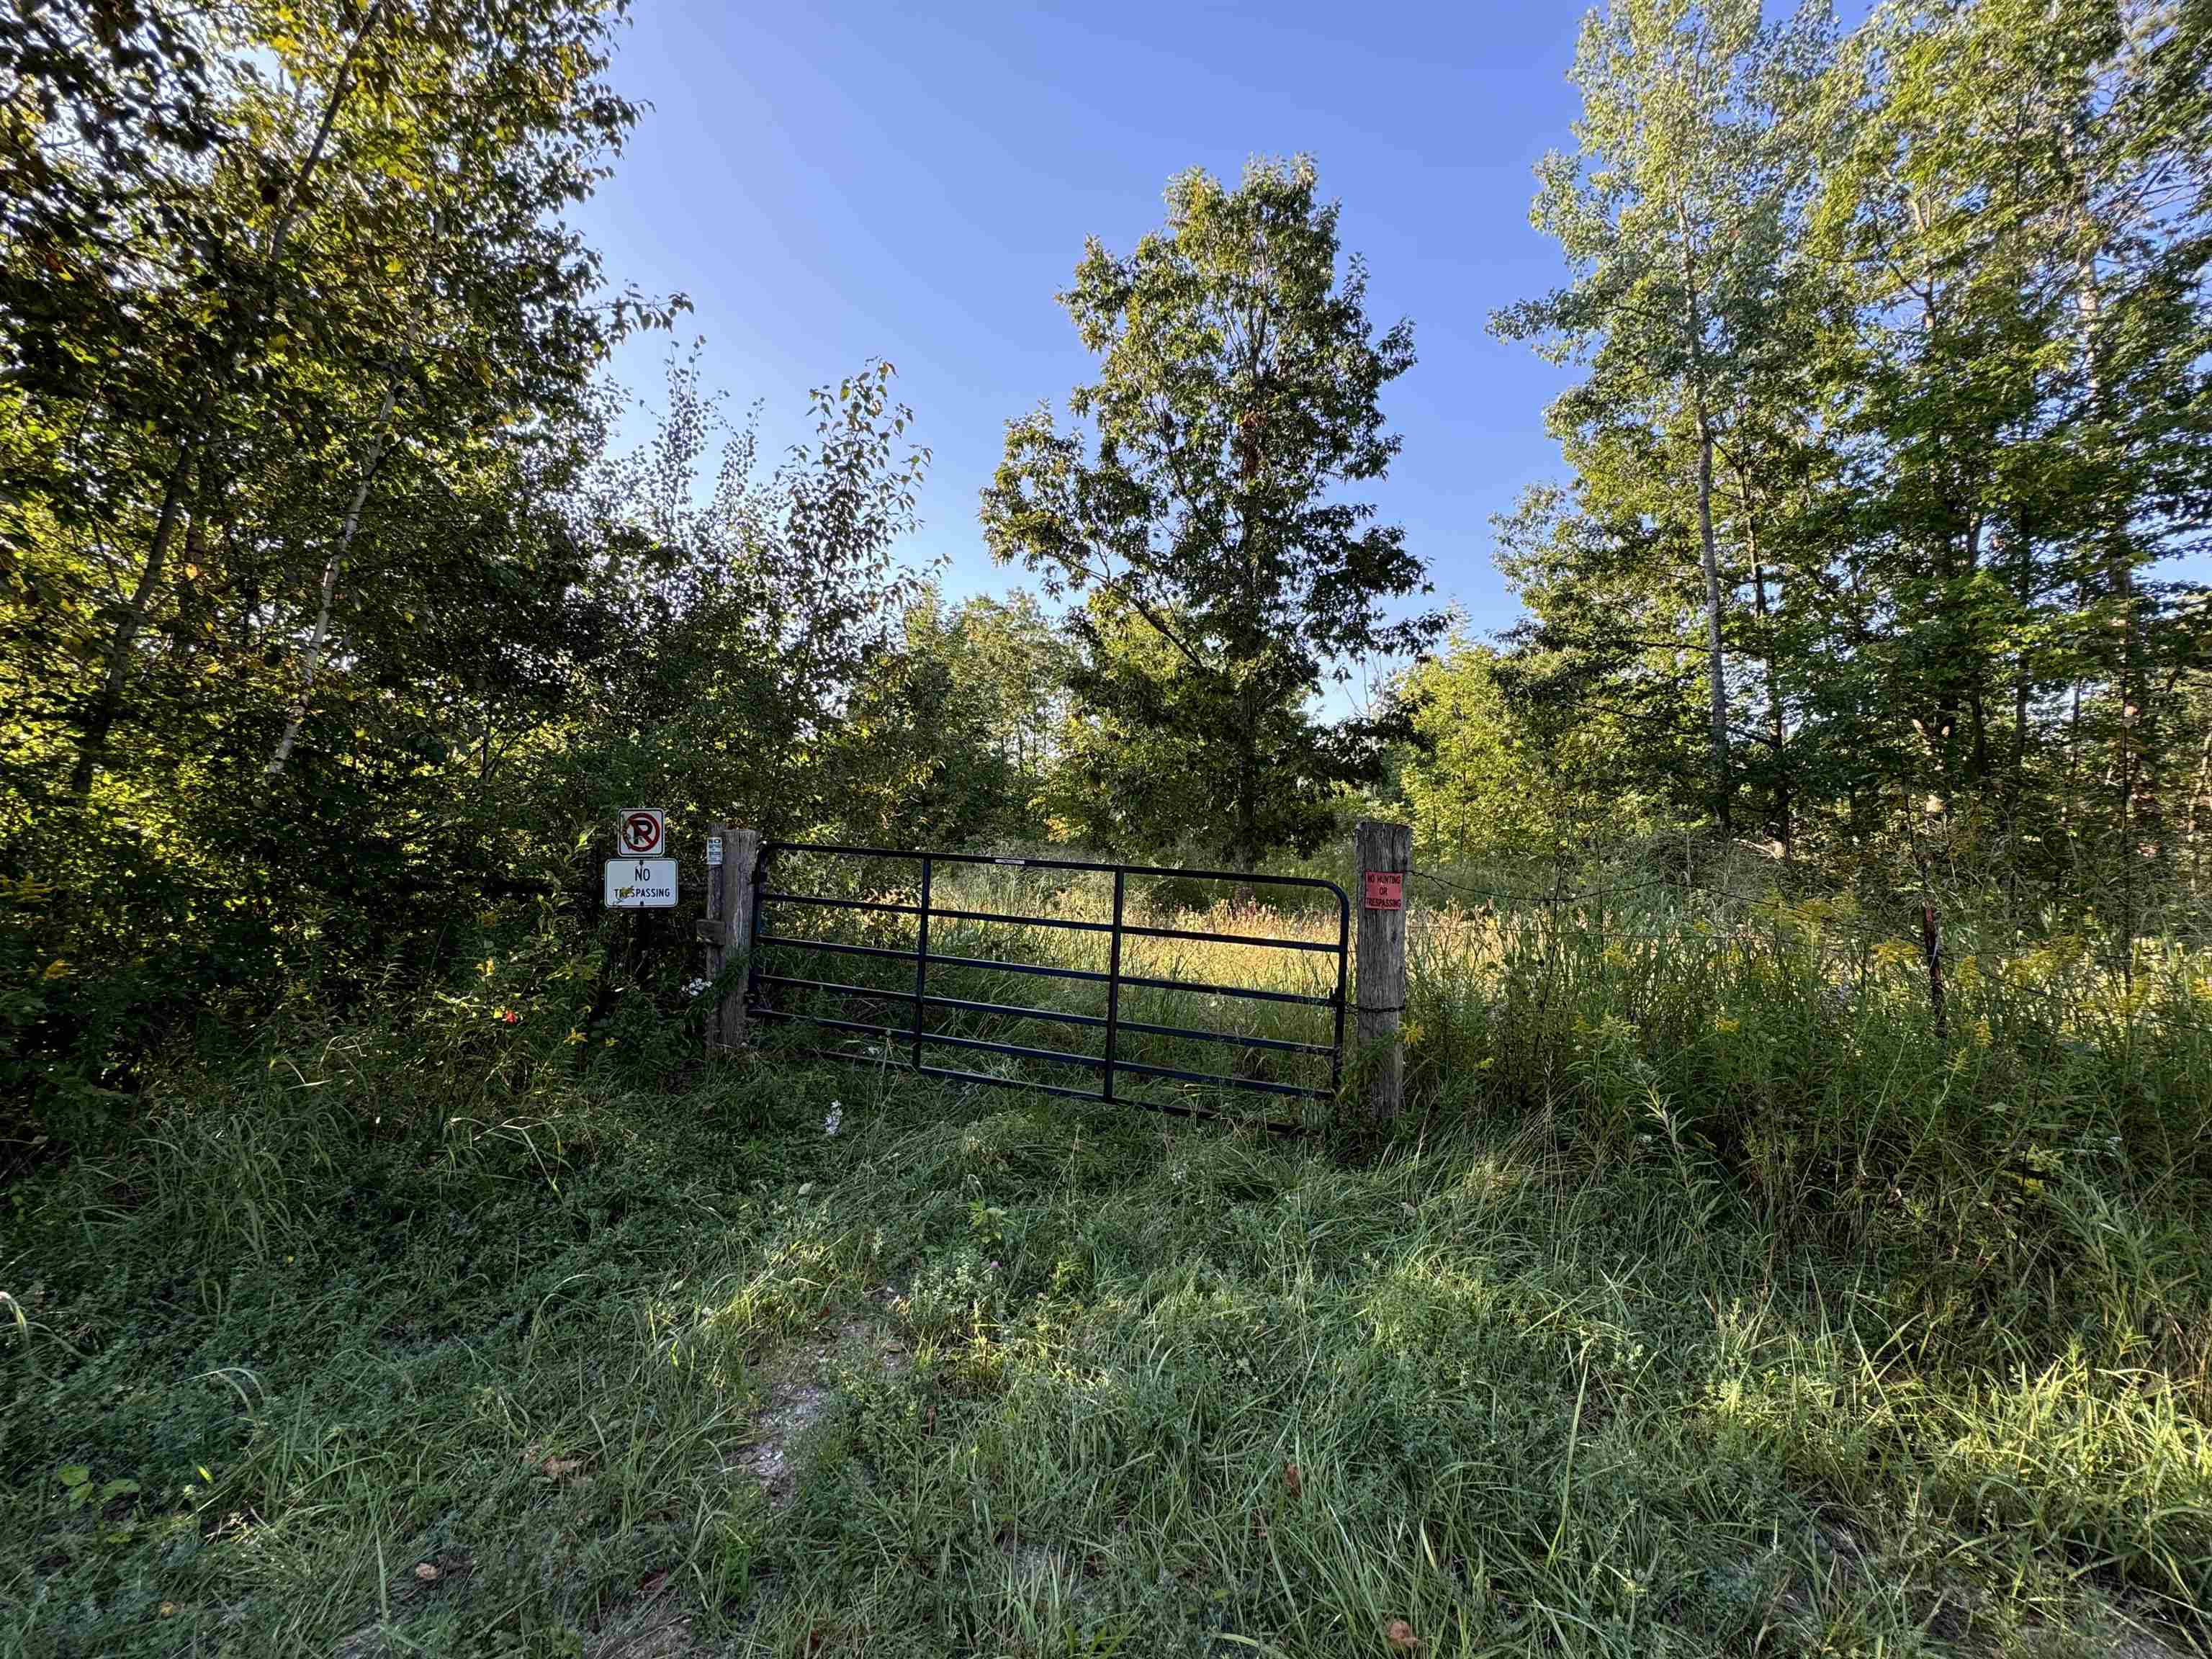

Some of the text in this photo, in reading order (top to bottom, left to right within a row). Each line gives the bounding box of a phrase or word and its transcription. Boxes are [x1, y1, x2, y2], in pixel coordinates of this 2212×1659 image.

[635, 868, 651, 881] NO
[1367, 874, 1401, 884] NO HUNTING
[614, 888, 670, 898] TSPASSING
[1379, 886, 1388, 896] OR
[1365, 898, 1401, 907] TRESPASSING
